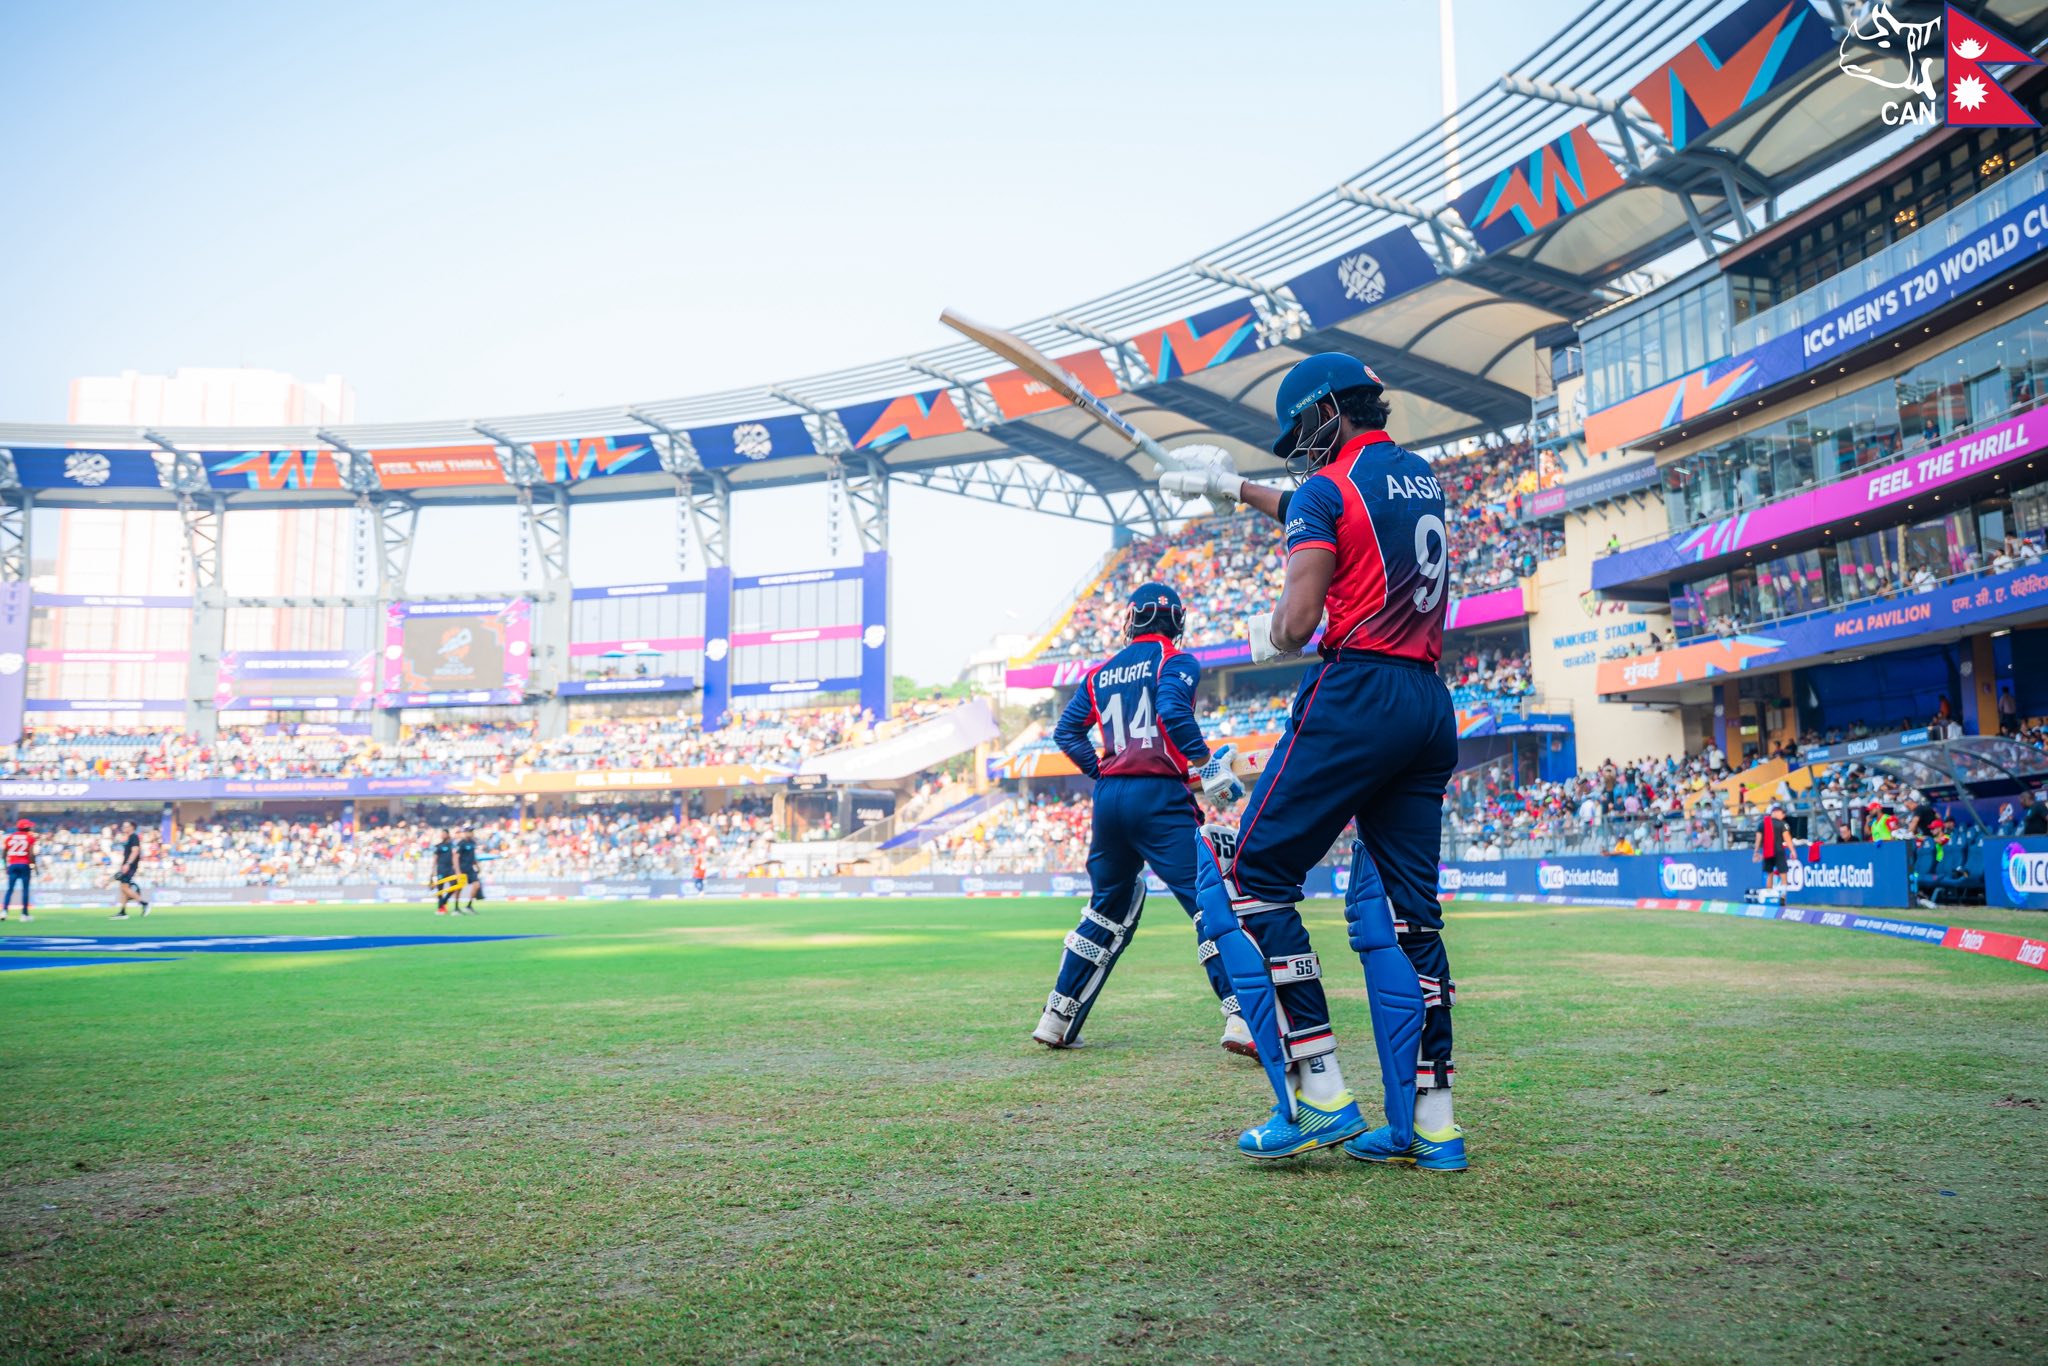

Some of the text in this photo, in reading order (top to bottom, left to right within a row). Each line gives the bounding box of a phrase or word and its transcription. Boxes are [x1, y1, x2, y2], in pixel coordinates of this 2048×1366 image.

[1803, 322, 1836, 357] ICC
[1837, 290, 1898, 340] MEN'S
[1901, 268, 1938, 307] T20
[1940, 223, 2019, 285] WORLD
[1868, 423, 2029, 501] FEEL THE THRILL
[1413, 514, 1447, 613] 9
[1604, 621, 1647, 640] STADIUM
[1834, 603, 1931, 637] MCA PAVILION
[1099, 661, 1152, 688] BHURTE
[1101, 686, 1158, 756] 14
[1848, 739, 1879, 756] ENGLAND
[8, 839, 29, 857] 22
[1210, 831, 1236, 859] SS
[1296, 959, 1313, 975] SS
